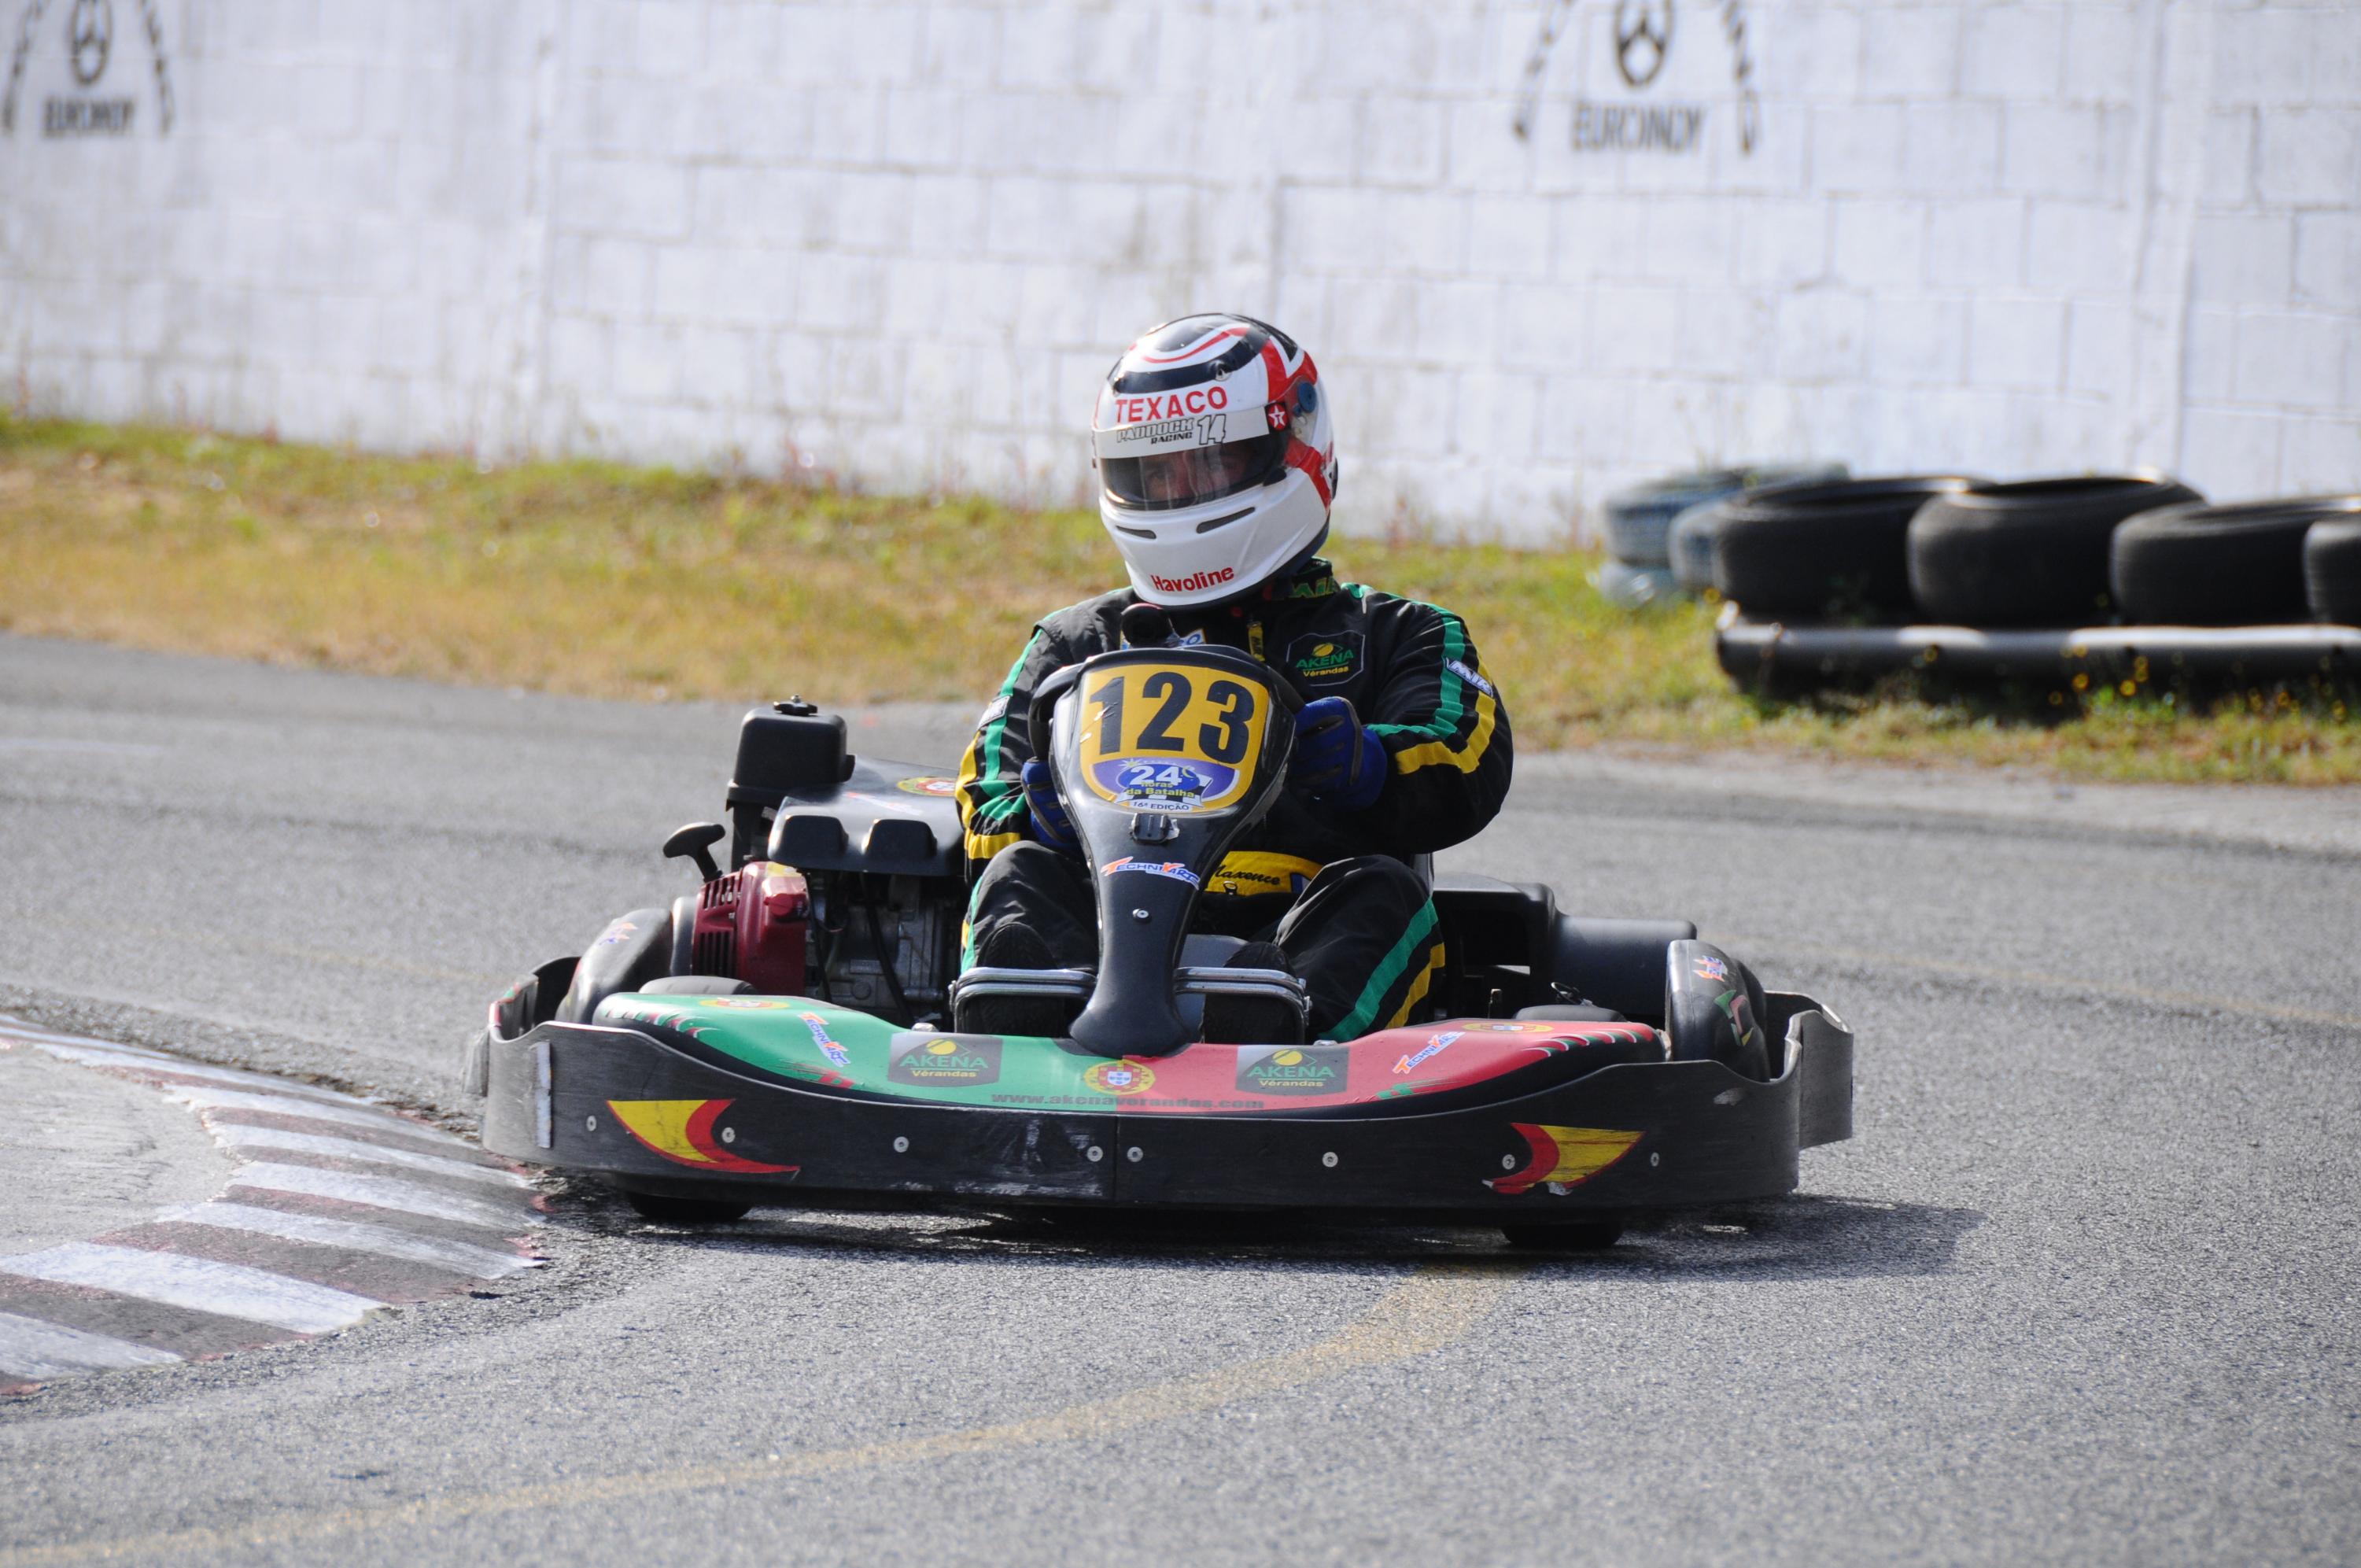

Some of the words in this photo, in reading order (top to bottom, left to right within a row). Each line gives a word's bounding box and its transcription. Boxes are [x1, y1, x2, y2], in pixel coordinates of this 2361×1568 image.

[1116, 386, 1227, 422] TEXACO
[1116, 418, 1194, 443] PADDOCK
[1197, 414, 1227, 445] 14
[1151, 432, 1193, 445] RACING
[1151, 566, 1234, 592] Havoline
[1296, 648, 1354, 668] AKENA
[1303, 666, 1349, 677] Vérandas
[1089, 671, 1255, 764] 123
[1130, 766, 1182, 786] 24
[1145, 788, 1195, 798] Batalha
[1151, 802, 1190, 810] EDIÇÃO
[900, 1055, 988, 1069] AKENA
[912, 1069, 977, 1078] Vérandas
[1247, 1066, 1336, 1078] AKENA
[991, 1093, 1265, 1109] www.akenaverandas.com
